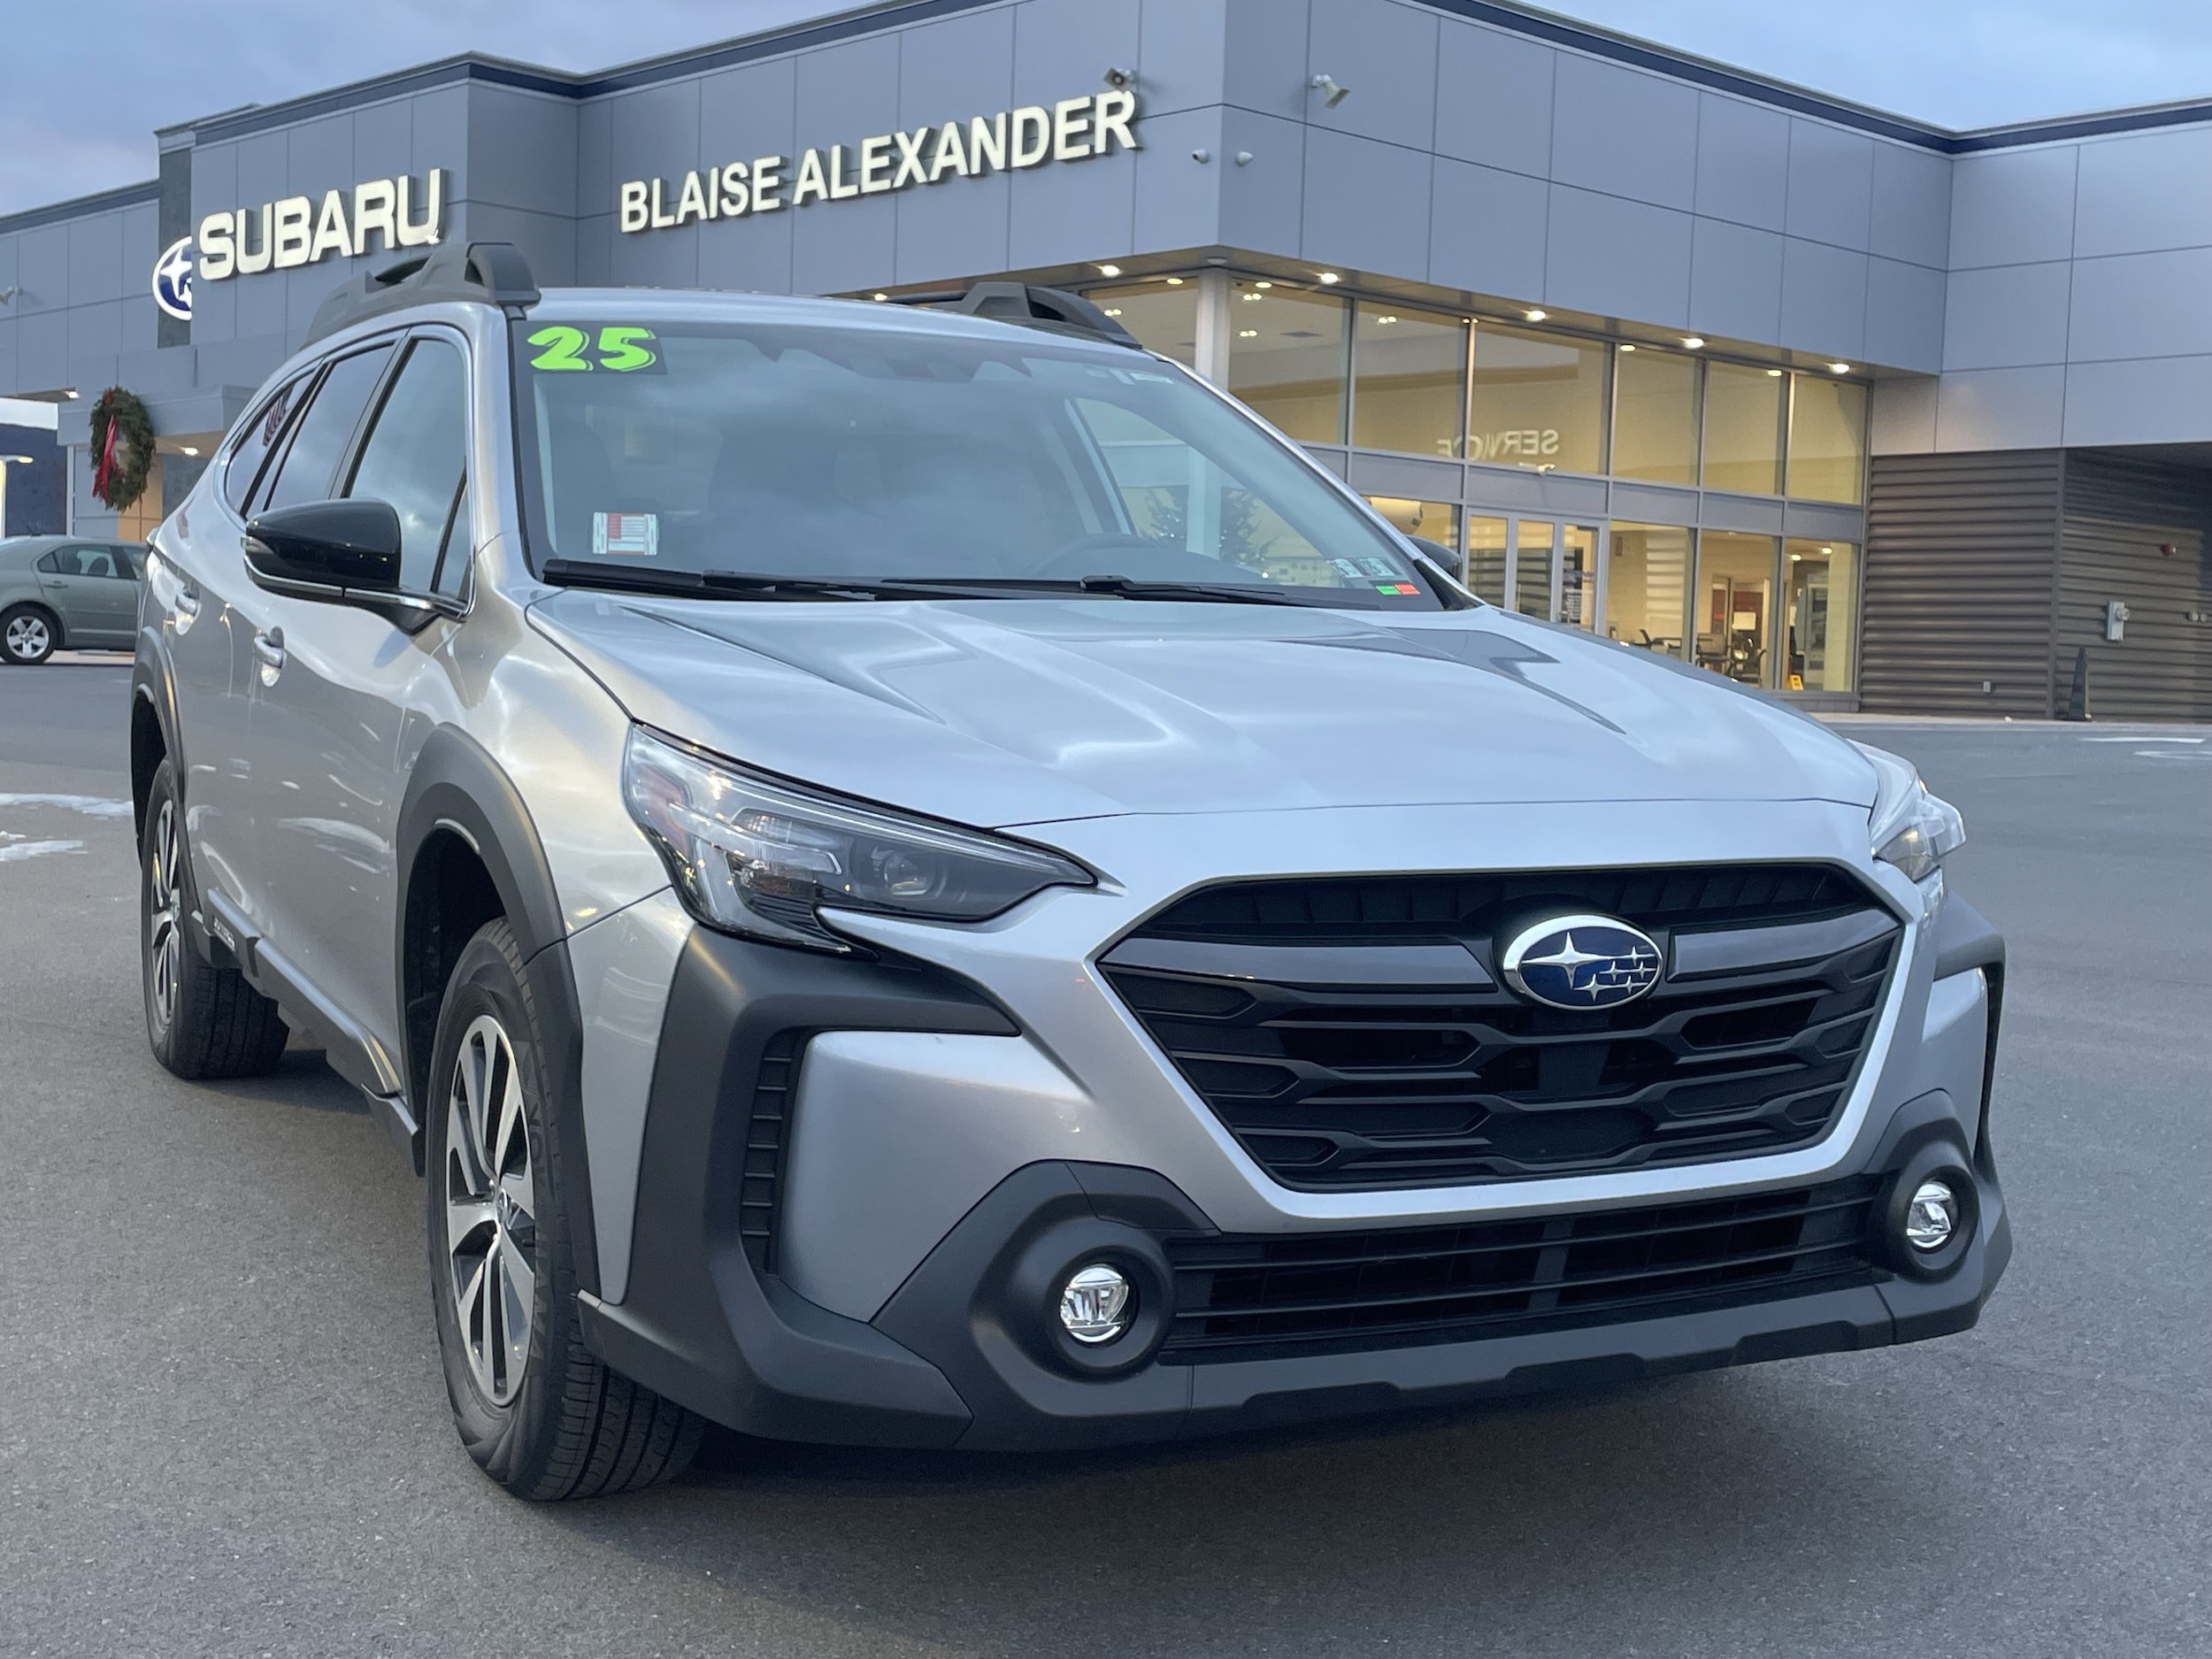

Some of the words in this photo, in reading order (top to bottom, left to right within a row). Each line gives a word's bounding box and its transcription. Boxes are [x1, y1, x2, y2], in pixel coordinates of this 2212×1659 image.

[620, 156, 782, 234] BLAISE
[793, 90, 1138, 205] ALEXANDER
[199, 168, 442, 280] SUBARU
[527, 326, 657, 372] 25
